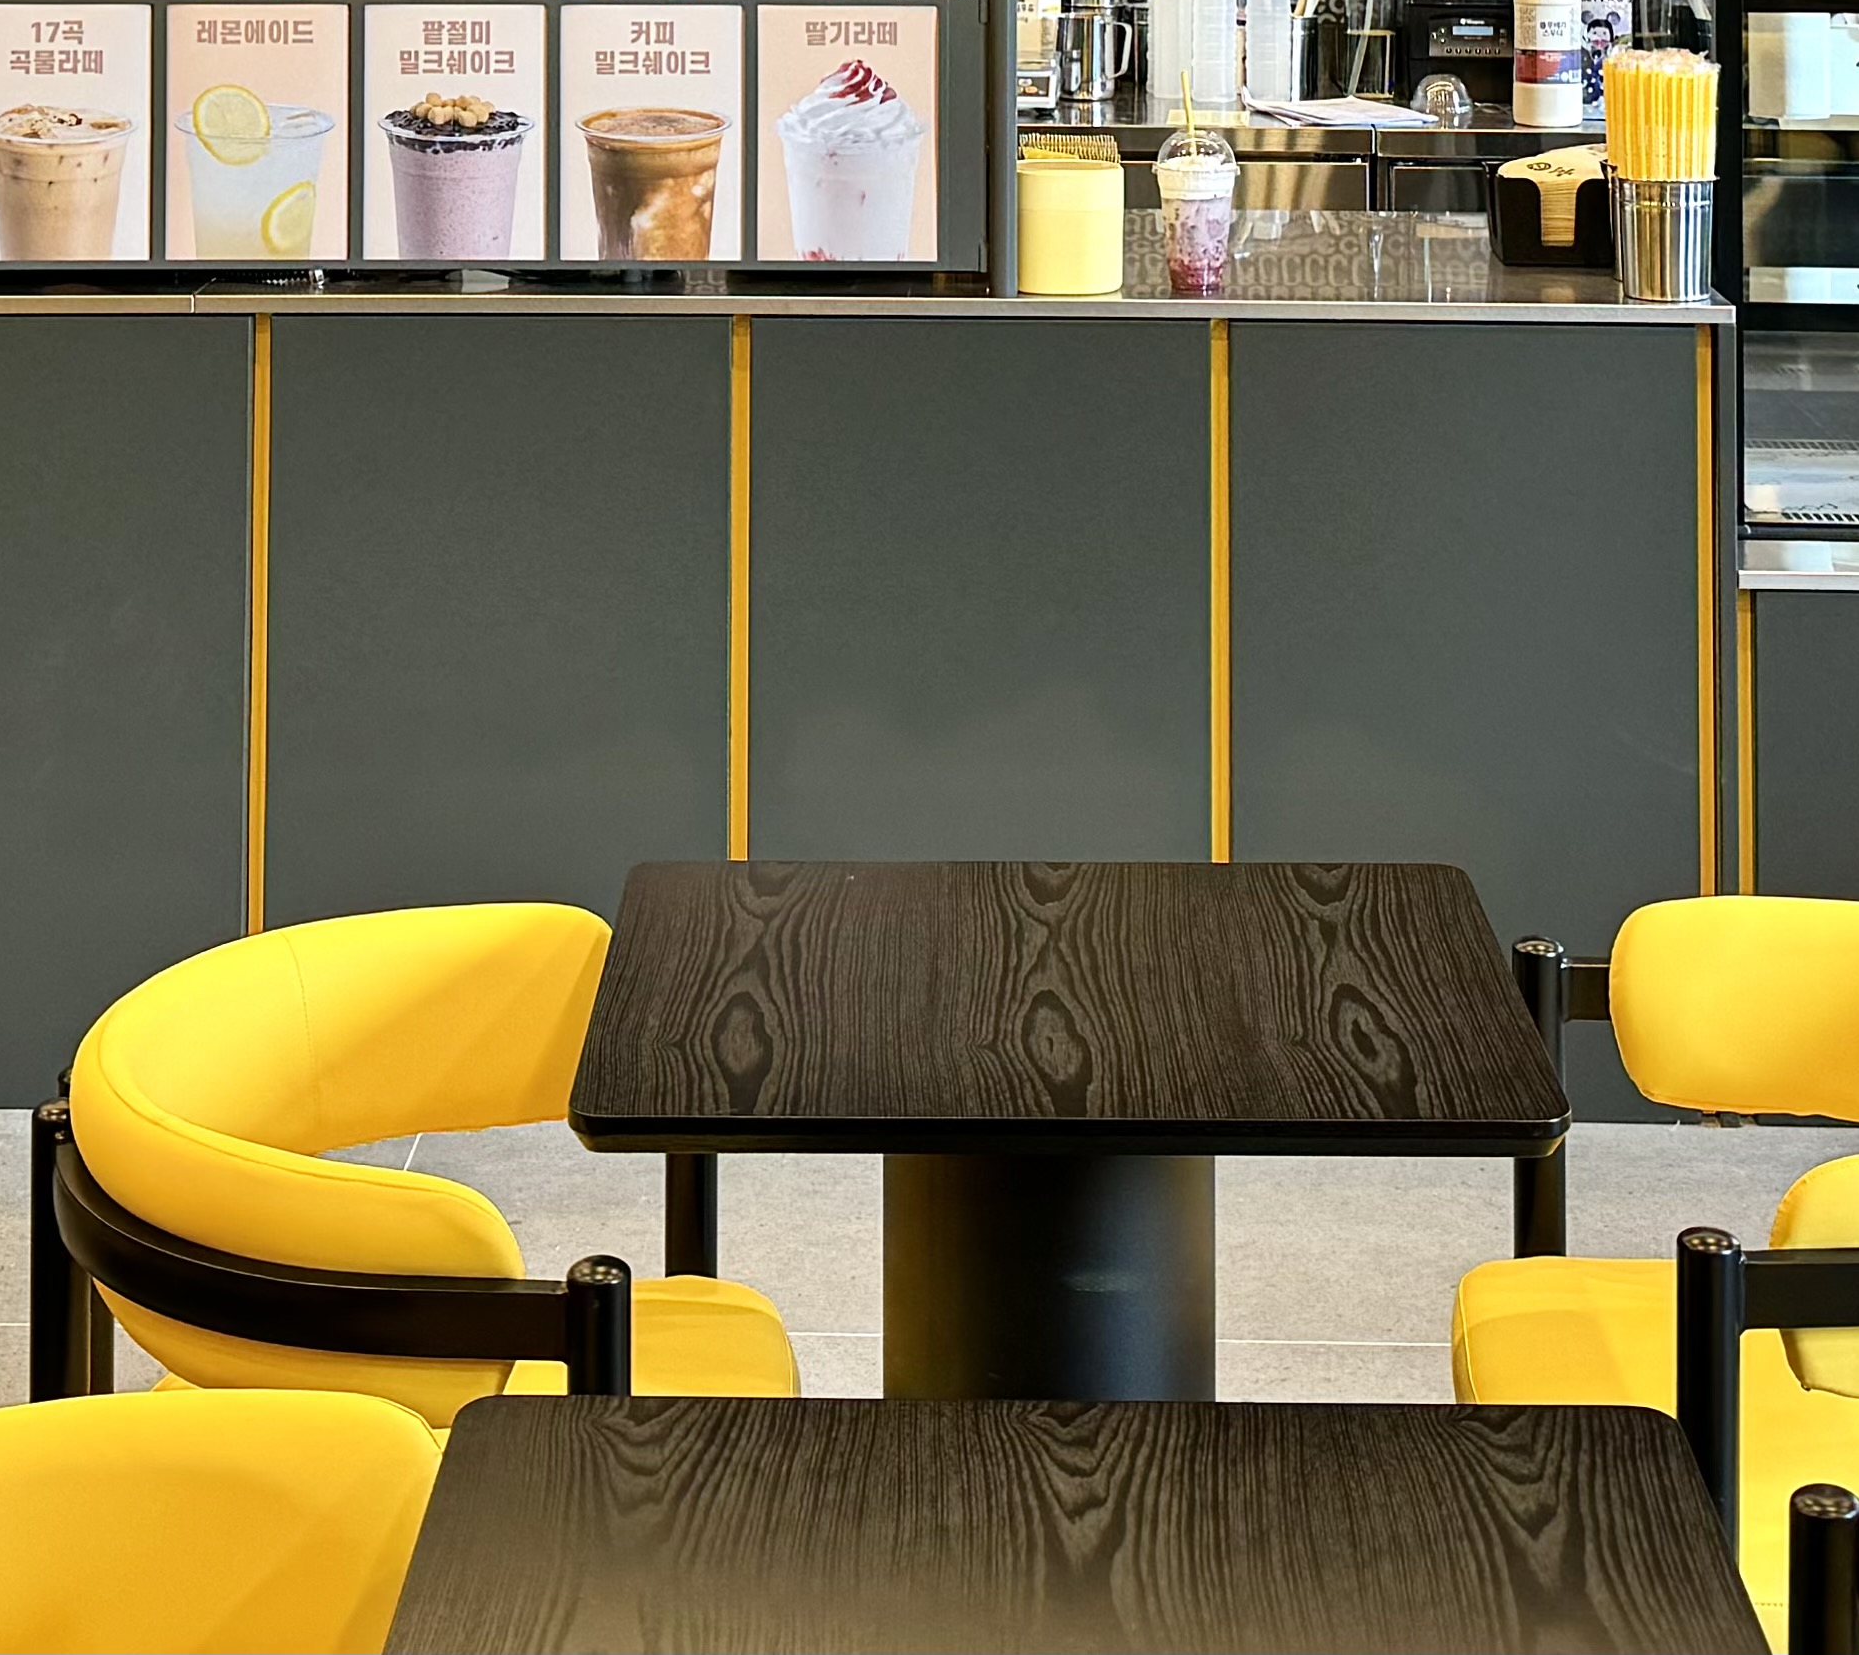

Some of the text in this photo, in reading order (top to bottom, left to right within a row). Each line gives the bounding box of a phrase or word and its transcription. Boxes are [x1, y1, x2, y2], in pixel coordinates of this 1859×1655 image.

[30, 20, 84, 46] 17곡
[196, 20, 314, 45] 레몬에이드
[422, 21, 491, 46] 팥절미
[630, 21, 675, 46] 커피
[805, 21, 898, 47] 딸기라떼
[9, 49, 104, 75] 곡물라떼
[399, 49, 516, 75] 밀크쉐이크
[595, 50, 711, 76] 밀크쉐이크
